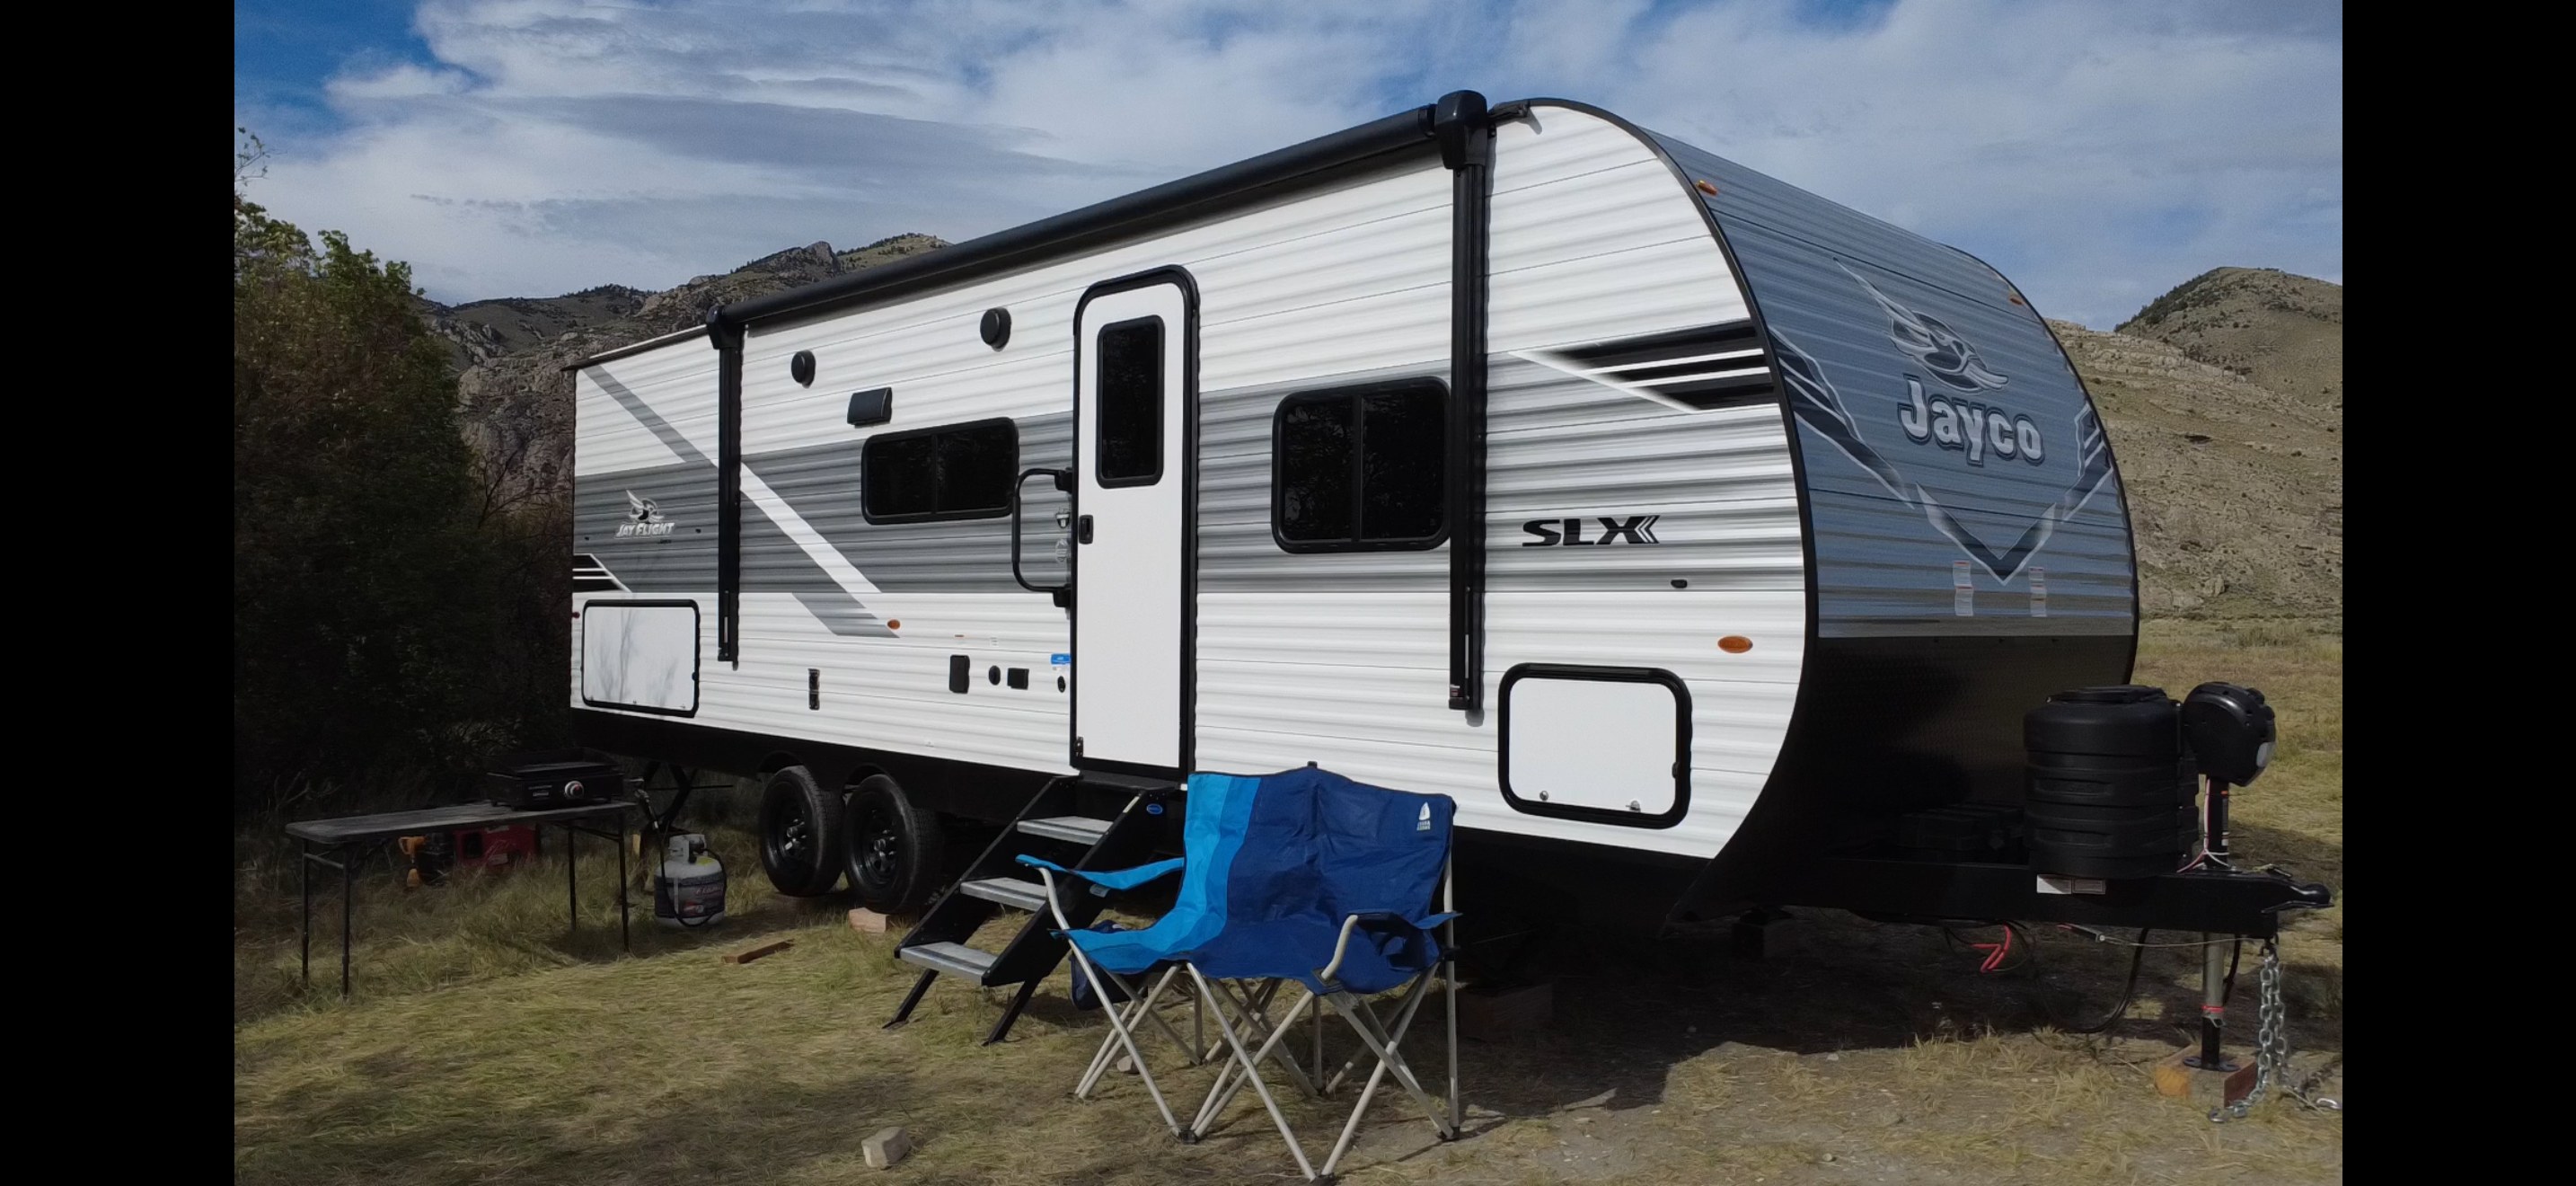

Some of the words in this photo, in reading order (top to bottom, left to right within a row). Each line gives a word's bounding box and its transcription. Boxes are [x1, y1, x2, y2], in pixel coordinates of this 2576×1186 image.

[1898, 375, 2043, 465] Jayco
[615, 523, 635, 537] JAY
[635, 522, 675, 536] FLIGHT
[1522, 515, 1660, 547] SLX
